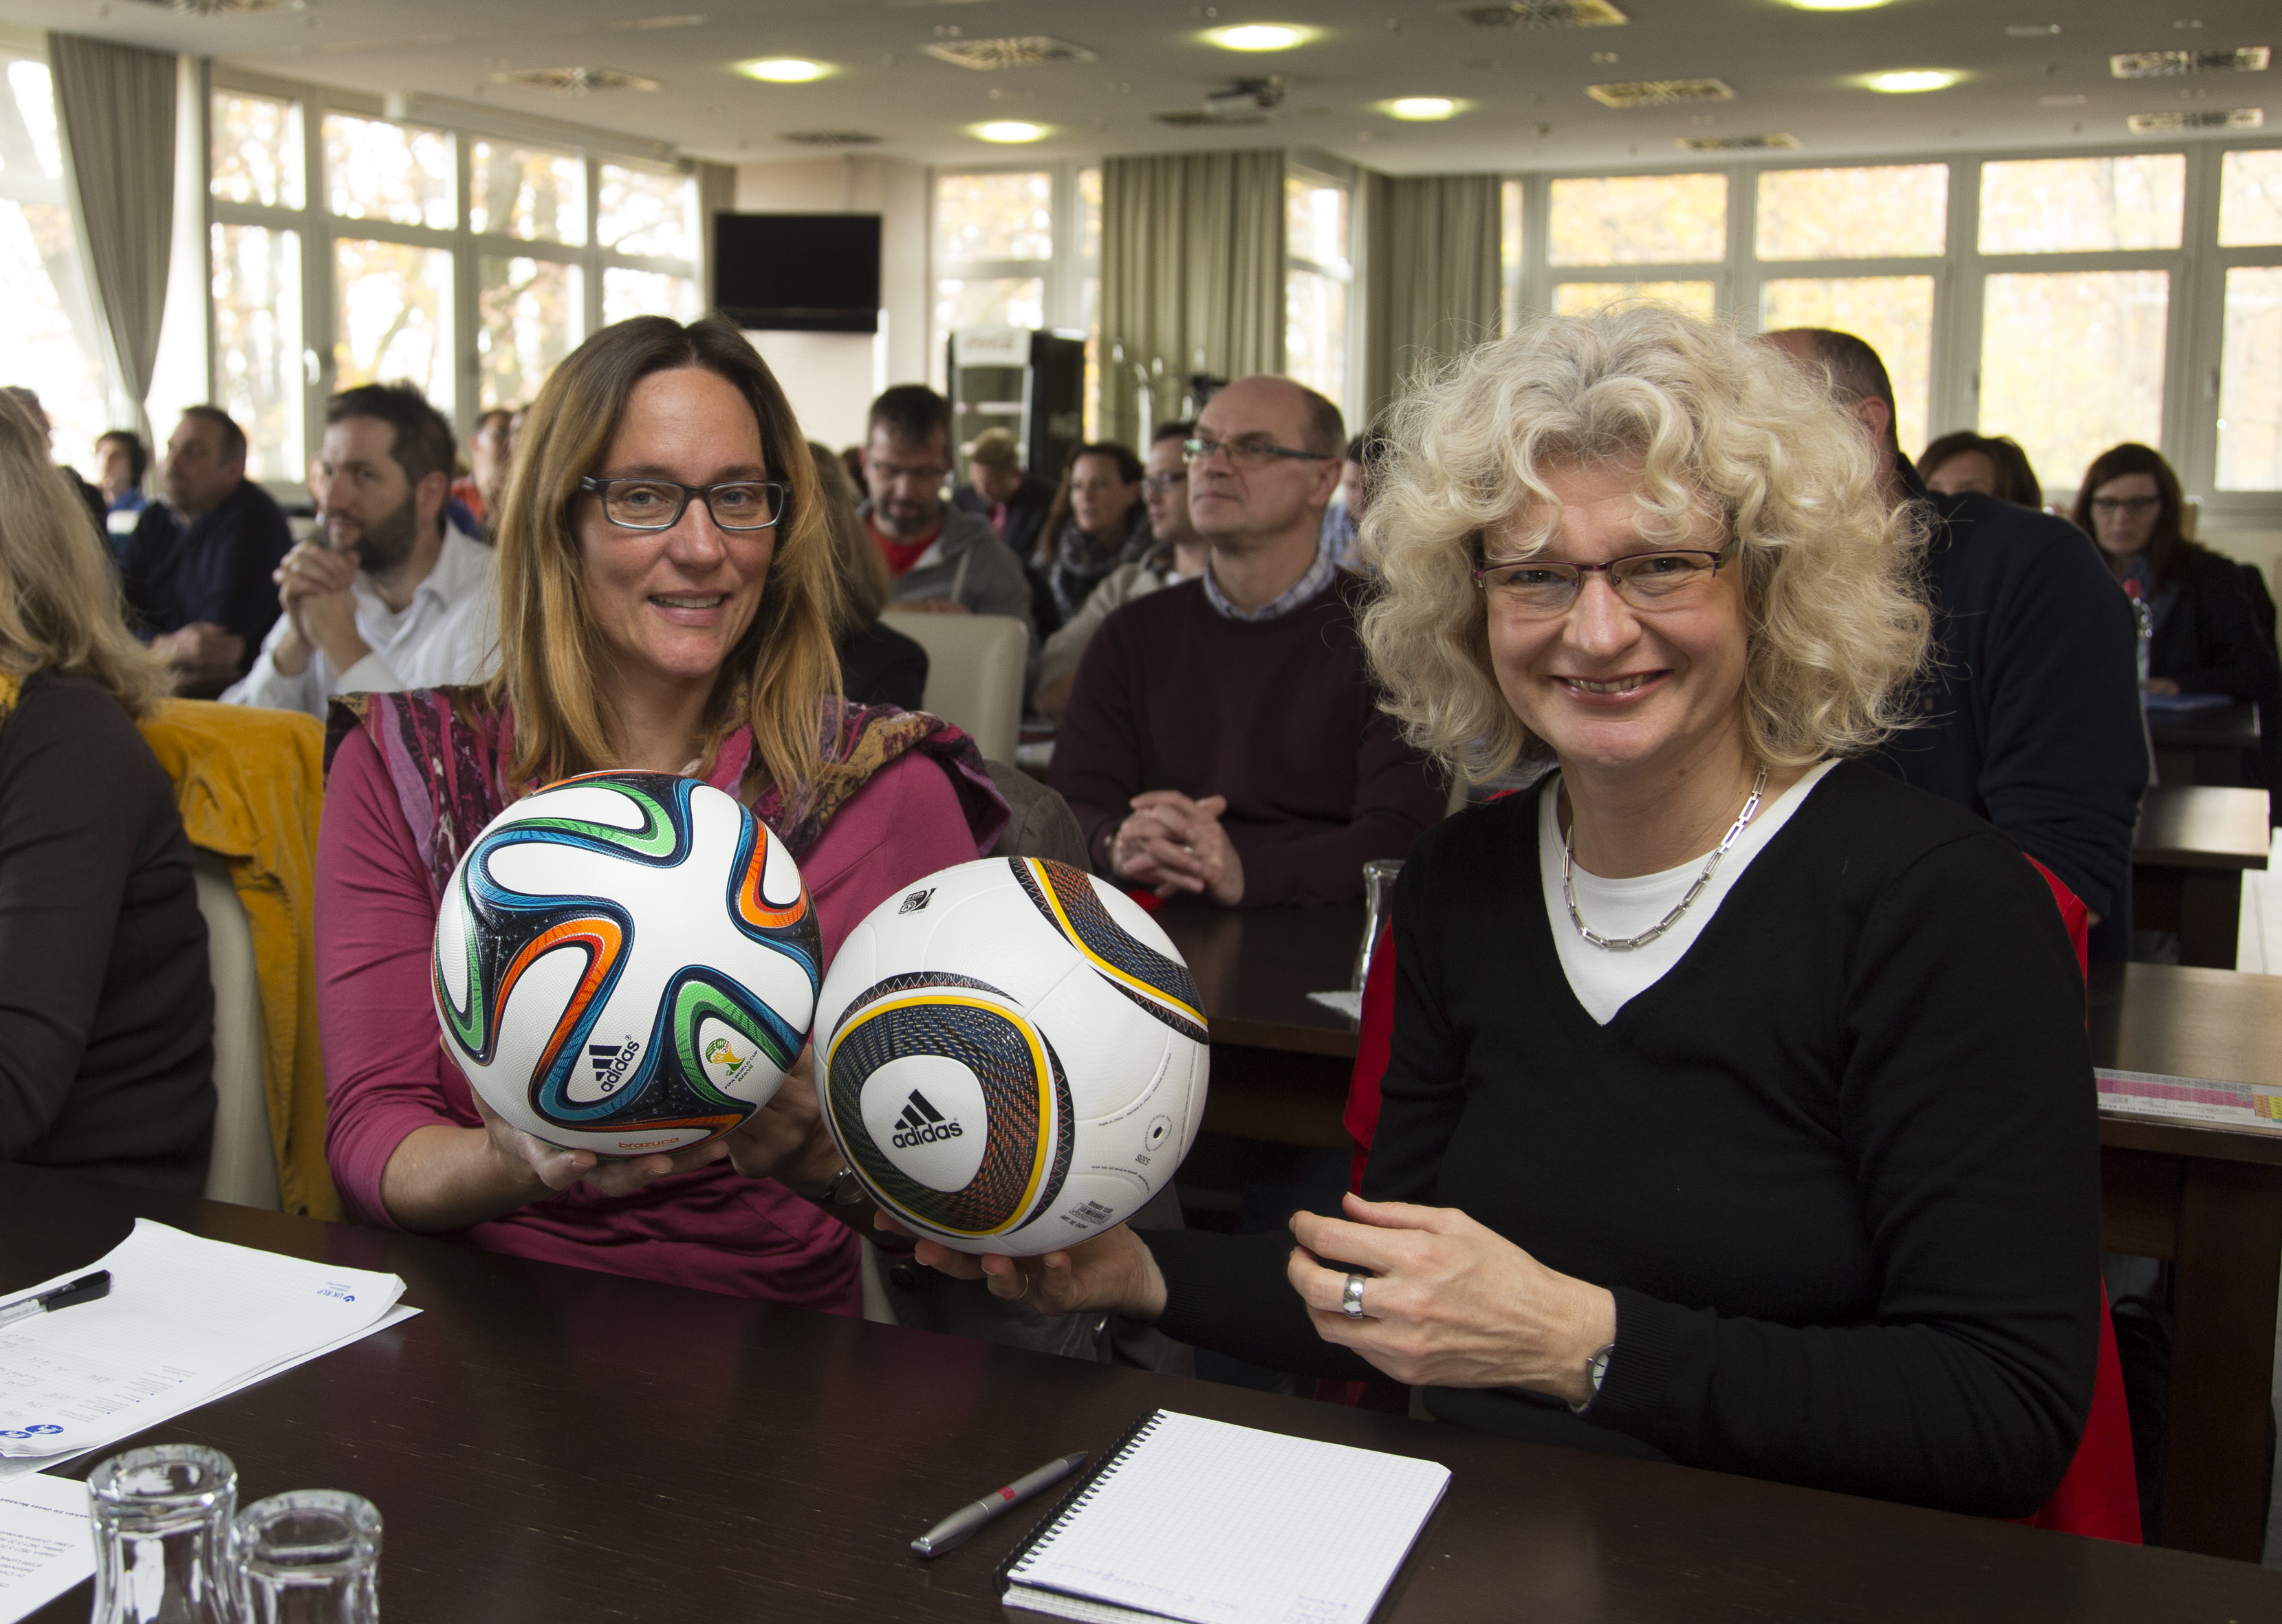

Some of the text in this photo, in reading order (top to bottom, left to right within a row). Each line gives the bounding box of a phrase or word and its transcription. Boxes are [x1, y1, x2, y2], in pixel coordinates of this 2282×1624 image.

[600, 1041, 640, 1092] adidas
[724, 1049, 759, 1089] FIFA WORLD CUP
[618, 1137, 680, 1148] brazuca
[892, 1122, 963, 1149] adidas
